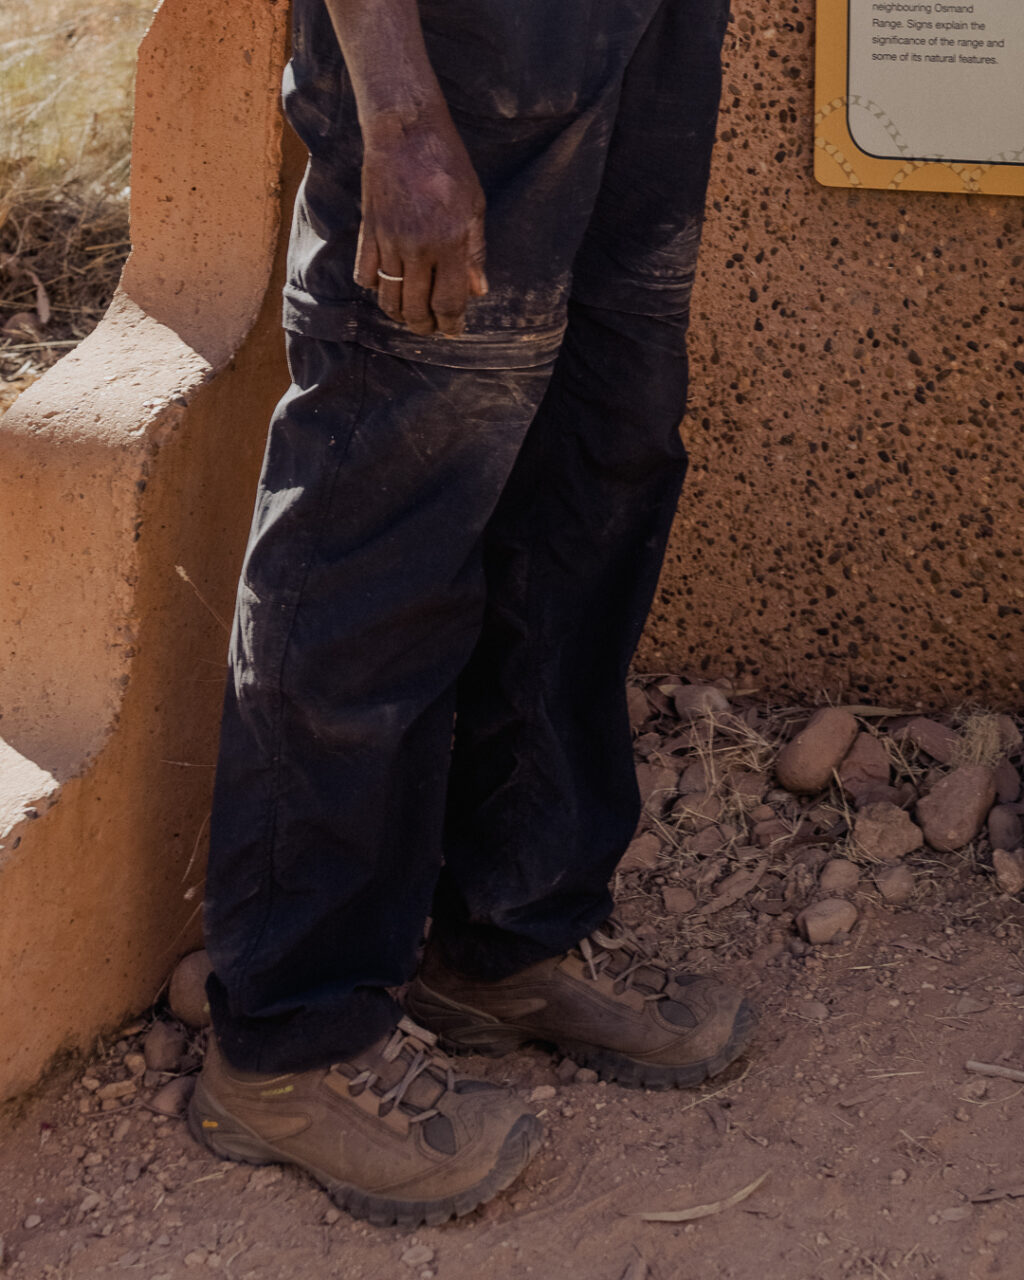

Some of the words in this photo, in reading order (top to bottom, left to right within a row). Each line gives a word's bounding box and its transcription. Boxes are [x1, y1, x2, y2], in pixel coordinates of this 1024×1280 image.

[872, 3, 932, 14] neighbouring
[934, 3, 974, 14] Osmand
[872, 18, 904, 30] Range.
[906, 19, 933, 31] Signs
[935, 21, 968, 31] explain
[970, 21, 986, 31] the
[872, 35, 926, 46] significance
[928, 36, 938, 46] of
[940, 37, 955, 47] the
[957, 39, 984, 49] range
[986, 39, 1005, 48] and
[871, 52, 897, 61] some
[899, 52, 909, 61] of
[911, 53, 922, 62] its
[924, 53, 956, 63] natural
[958, 53, 999, 64] features.
